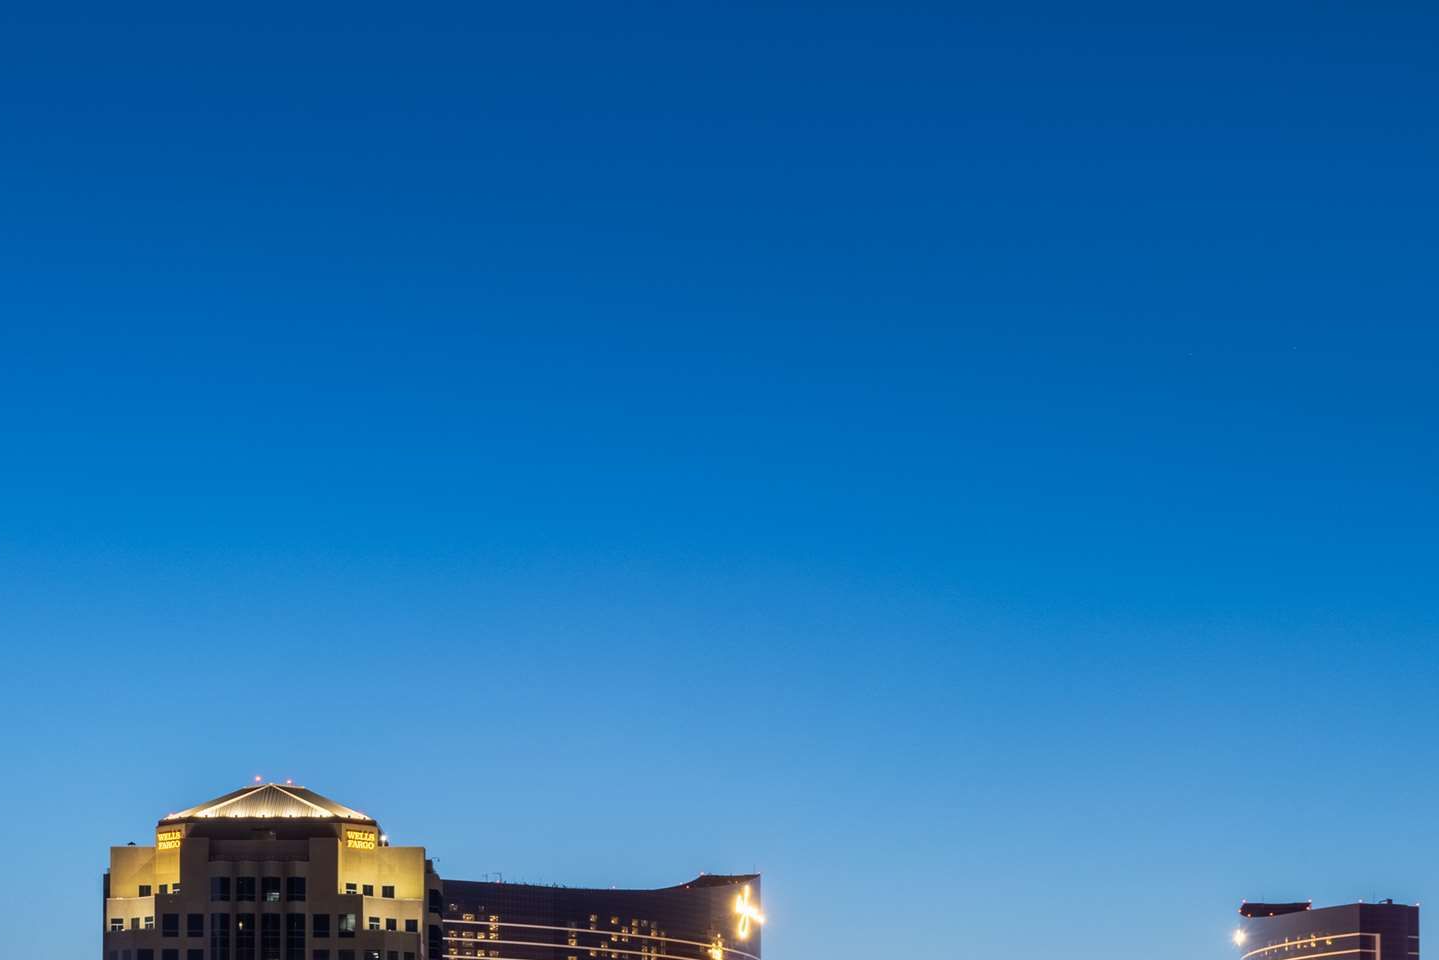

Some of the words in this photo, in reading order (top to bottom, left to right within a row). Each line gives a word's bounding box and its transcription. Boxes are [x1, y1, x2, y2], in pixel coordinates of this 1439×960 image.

[158, 832, 181, 841] WELLS
[347, 831, 375, 842] WELLS
[347, 840, 375, 850] FARGO
